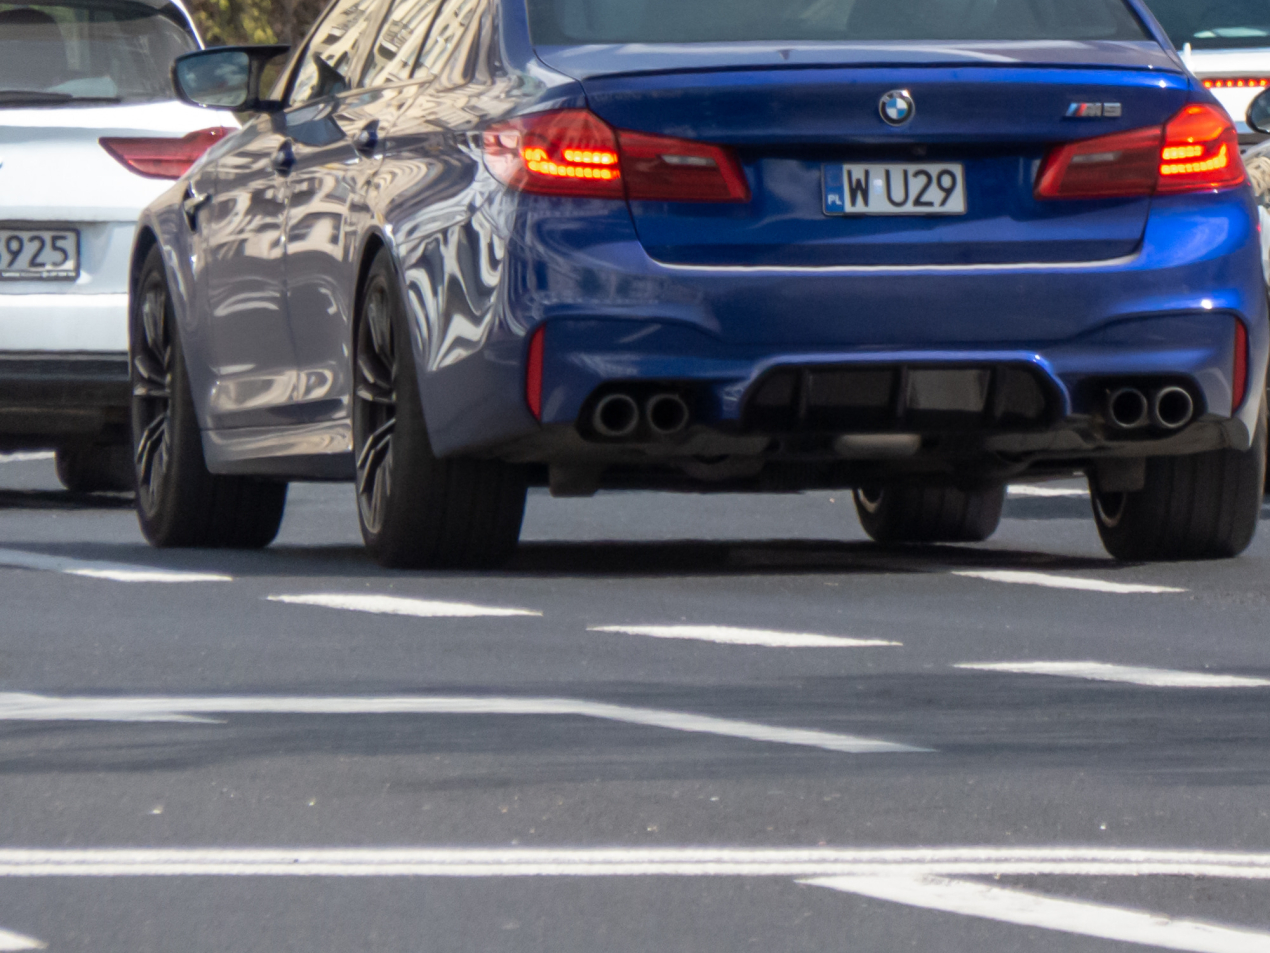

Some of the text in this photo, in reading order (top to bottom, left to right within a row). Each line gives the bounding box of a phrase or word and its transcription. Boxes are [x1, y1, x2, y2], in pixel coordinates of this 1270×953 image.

[828, 169, 957, 208] PL W U29
[0, 234, 69, 268] 925
